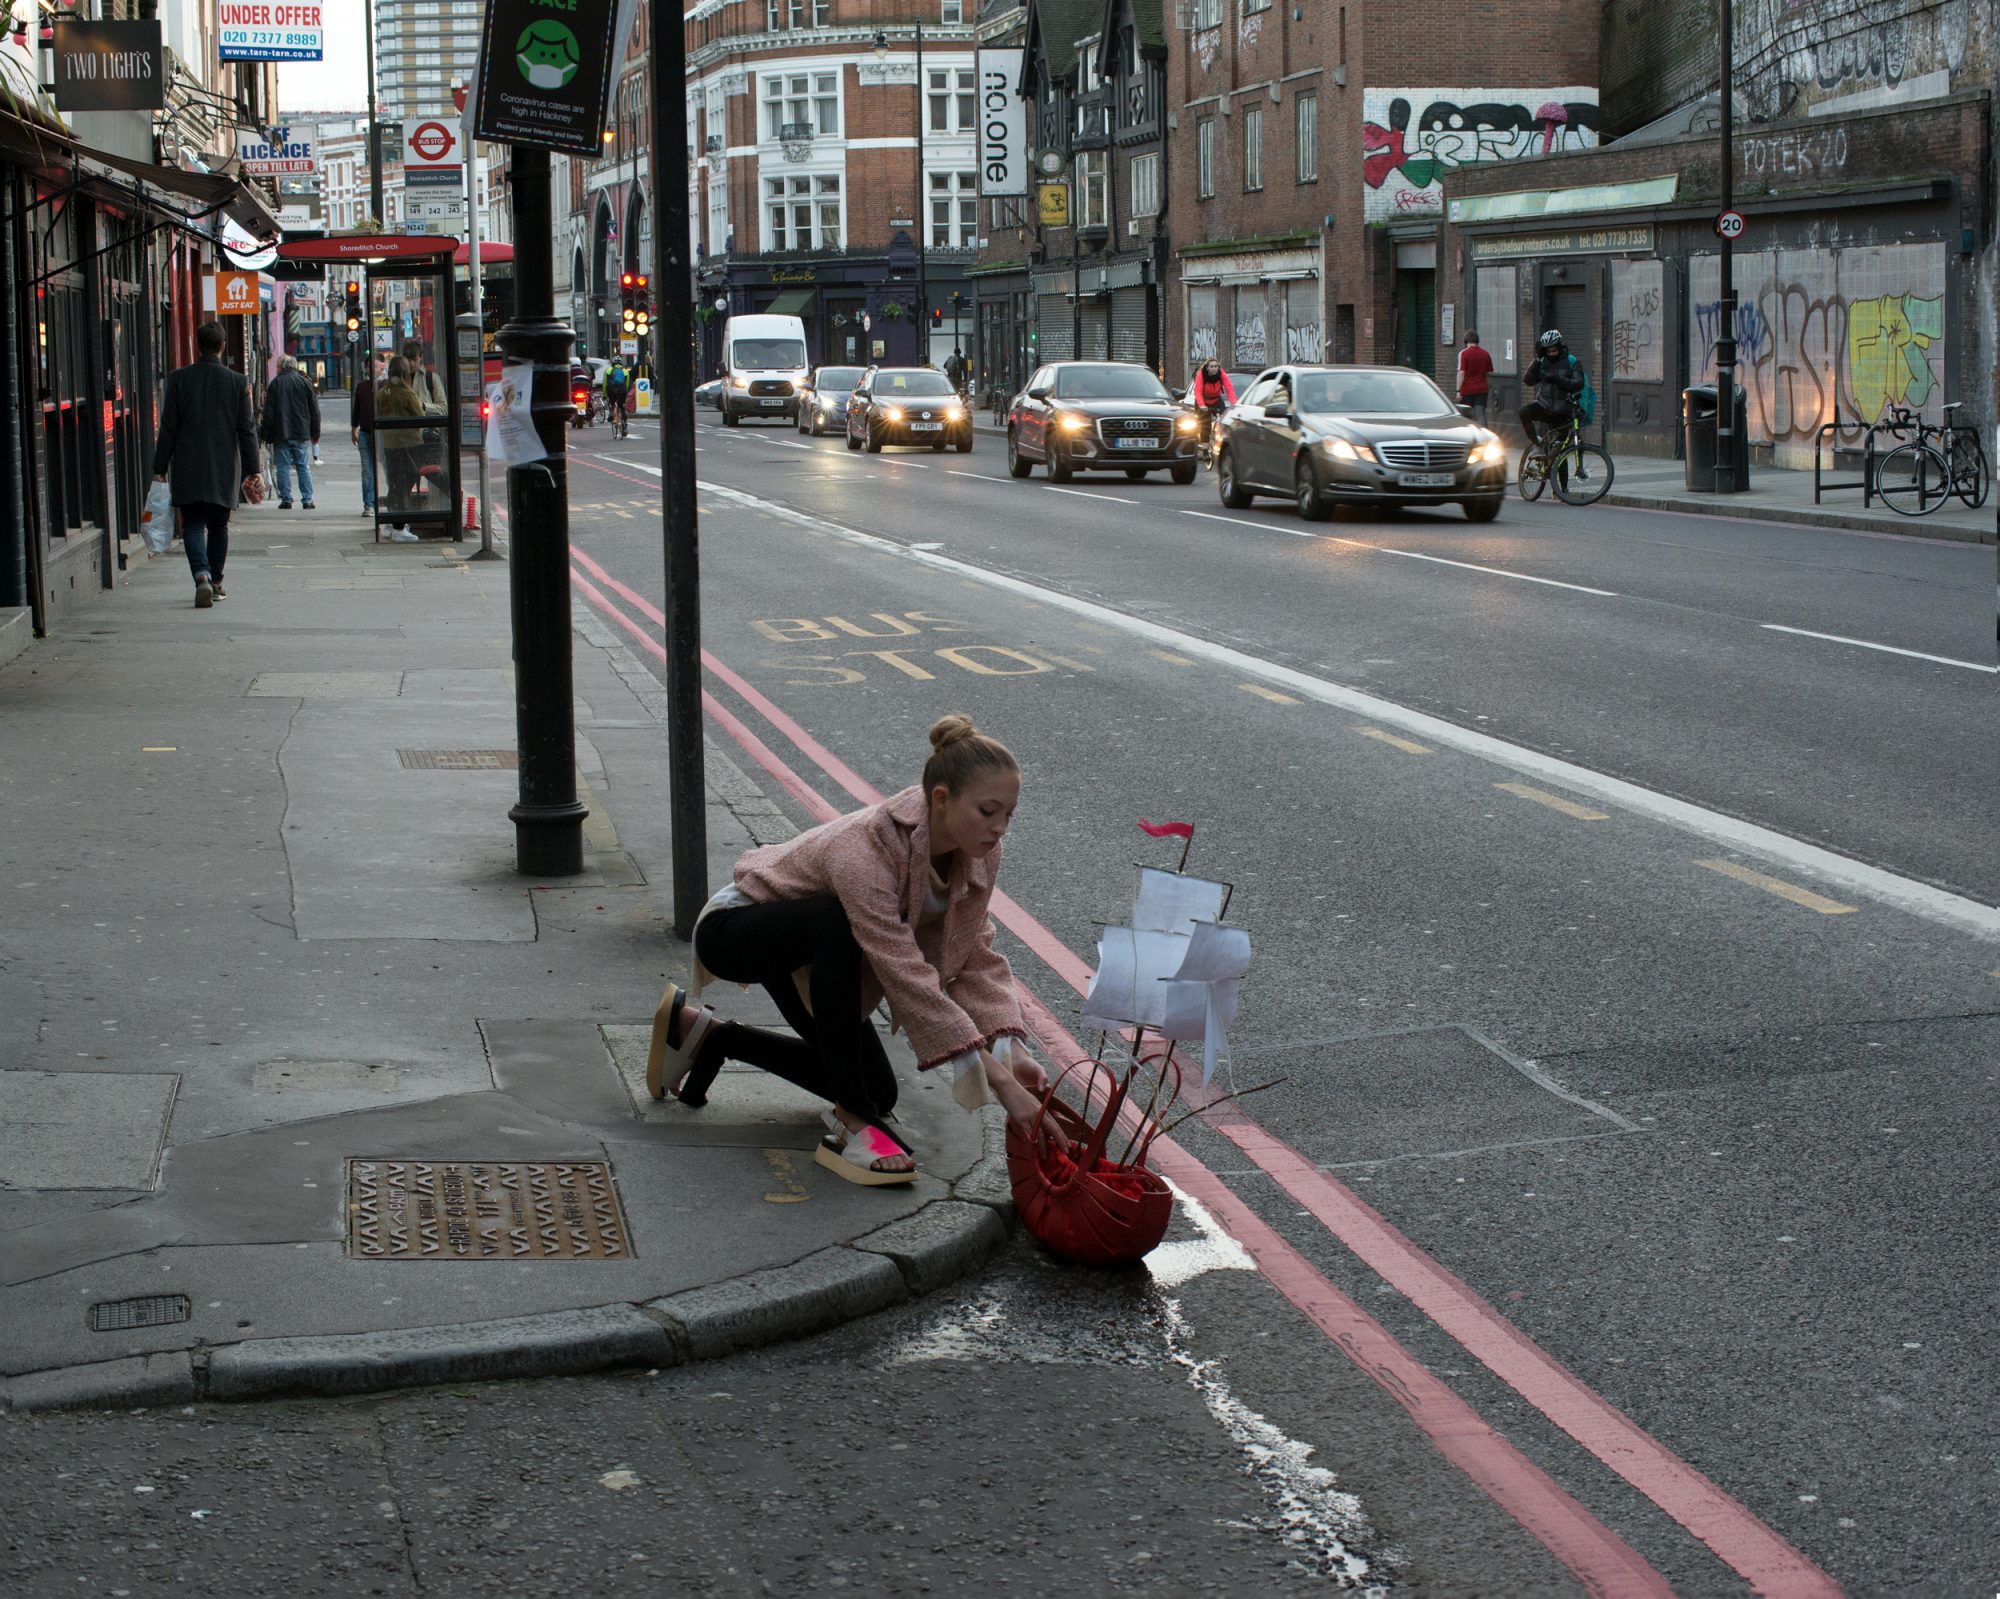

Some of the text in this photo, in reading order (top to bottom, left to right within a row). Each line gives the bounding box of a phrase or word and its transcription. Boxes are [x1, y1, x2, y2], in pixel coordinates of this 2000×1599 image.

[221, 5, 321, 26] UNDER OFFER
[224, 31, 317, 46] 020 7377 8989
[224, 48, 317, 58] www.tarn-tarn.co.uk
[64, 51, 152, 80] TWO LIGHTS
[500, 93, 585, 113] Coronavirus cases are
[511, 105, 572, 124] high in Hackney
[496, 121, 584, 142] Protect your friends and family
[985, 72, 1008, 183] no.one
[242, 143, 311, 159] LICENCE
[246, 161, 309, 173] OPEN TILL LATE
[1722, 219, 1741, 231] 20
[1579, 234, 1591, 247] tel:
[1592, 232, 1606, 247] 020
[1608, 231, 1626, 246] 7739
[1628, 230, 1647, 245] 7335
[221, 302, 239, 310] JUST
[752, 611, 980, 642] BUS
